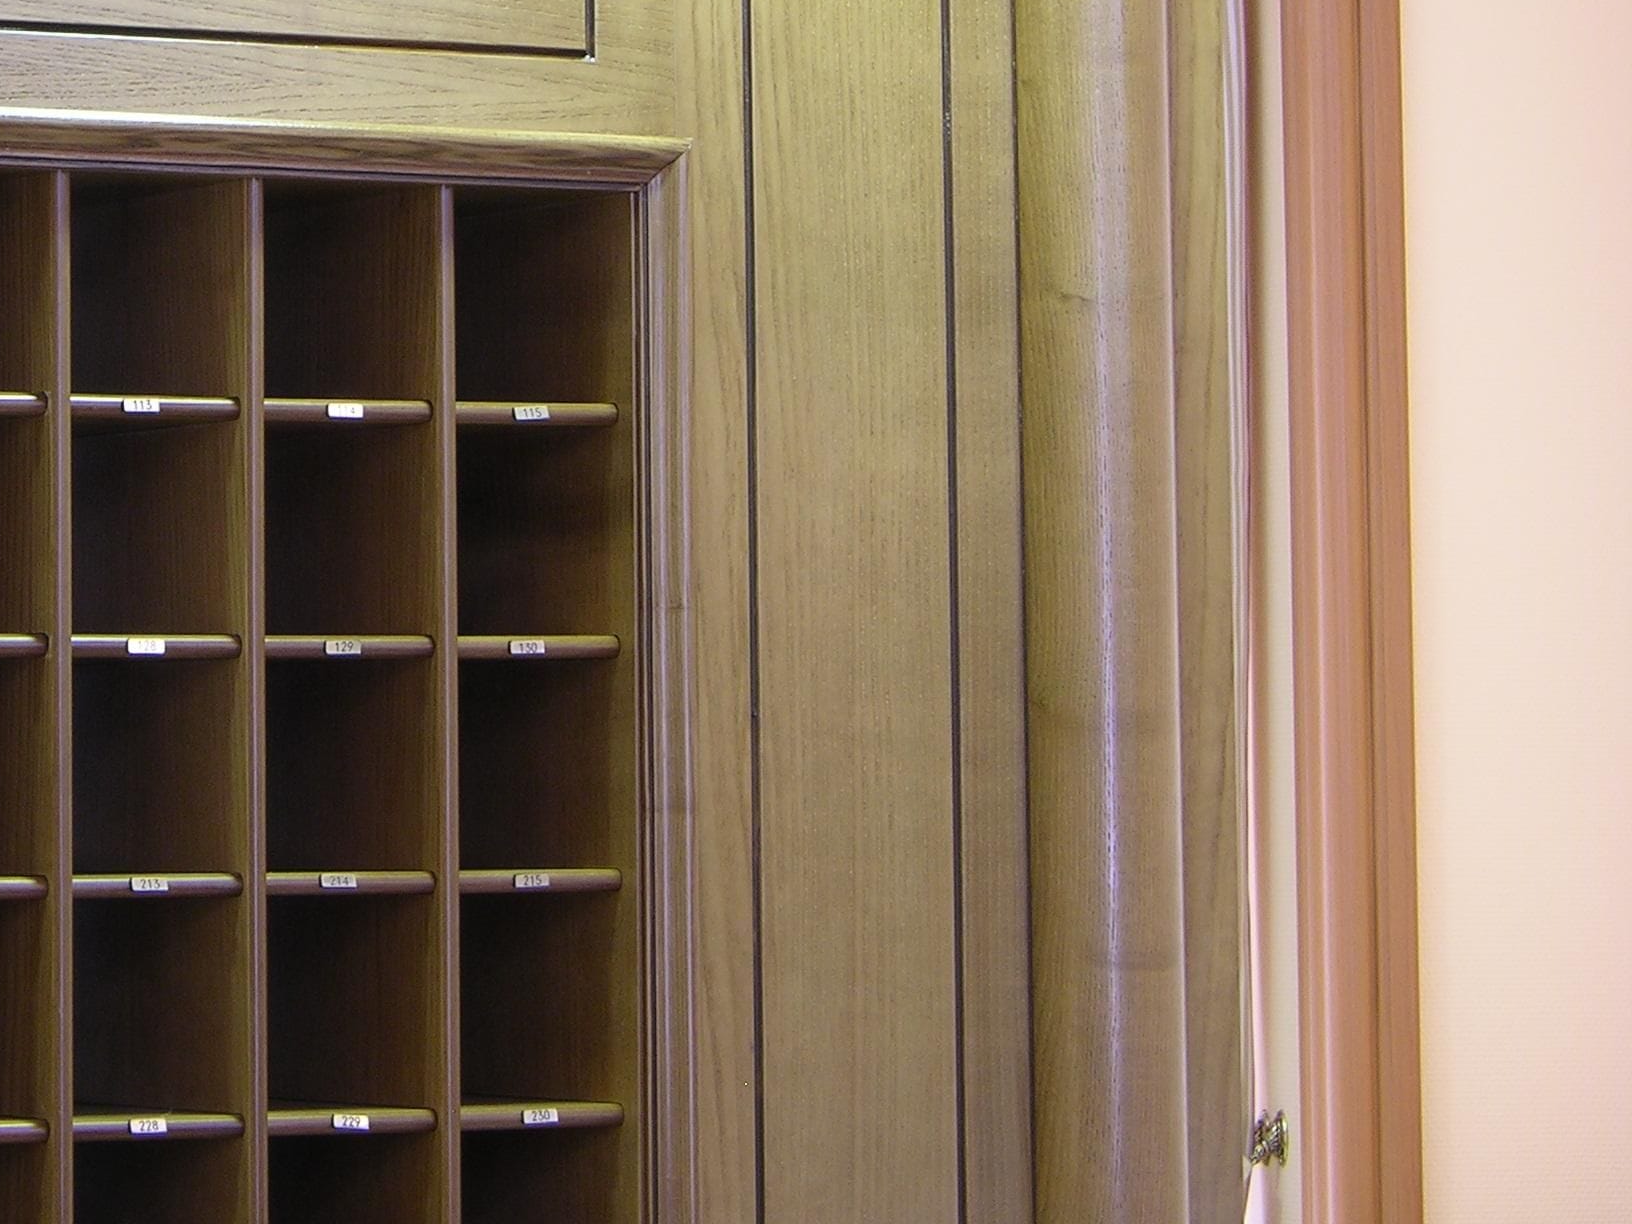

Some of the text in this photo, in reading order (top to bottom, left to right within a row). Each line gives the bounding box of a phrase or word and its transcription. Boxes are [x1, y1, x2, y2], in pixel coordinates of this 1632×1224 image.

[133, 399, 153, 410] 113
[523, 407, 542, 418] 115
[335, 641, 354, 652] 129
[519, 642, 538, 654] 130
[140, 879, 161, 890] 213
[330, 875, 349, 886] 214
[523, 875, 542, 886] 215
[342, 1116, 361, 1127] 229
[532, 1110, 551, 1122] 230
[139, 1119, 159, 1131] 228
